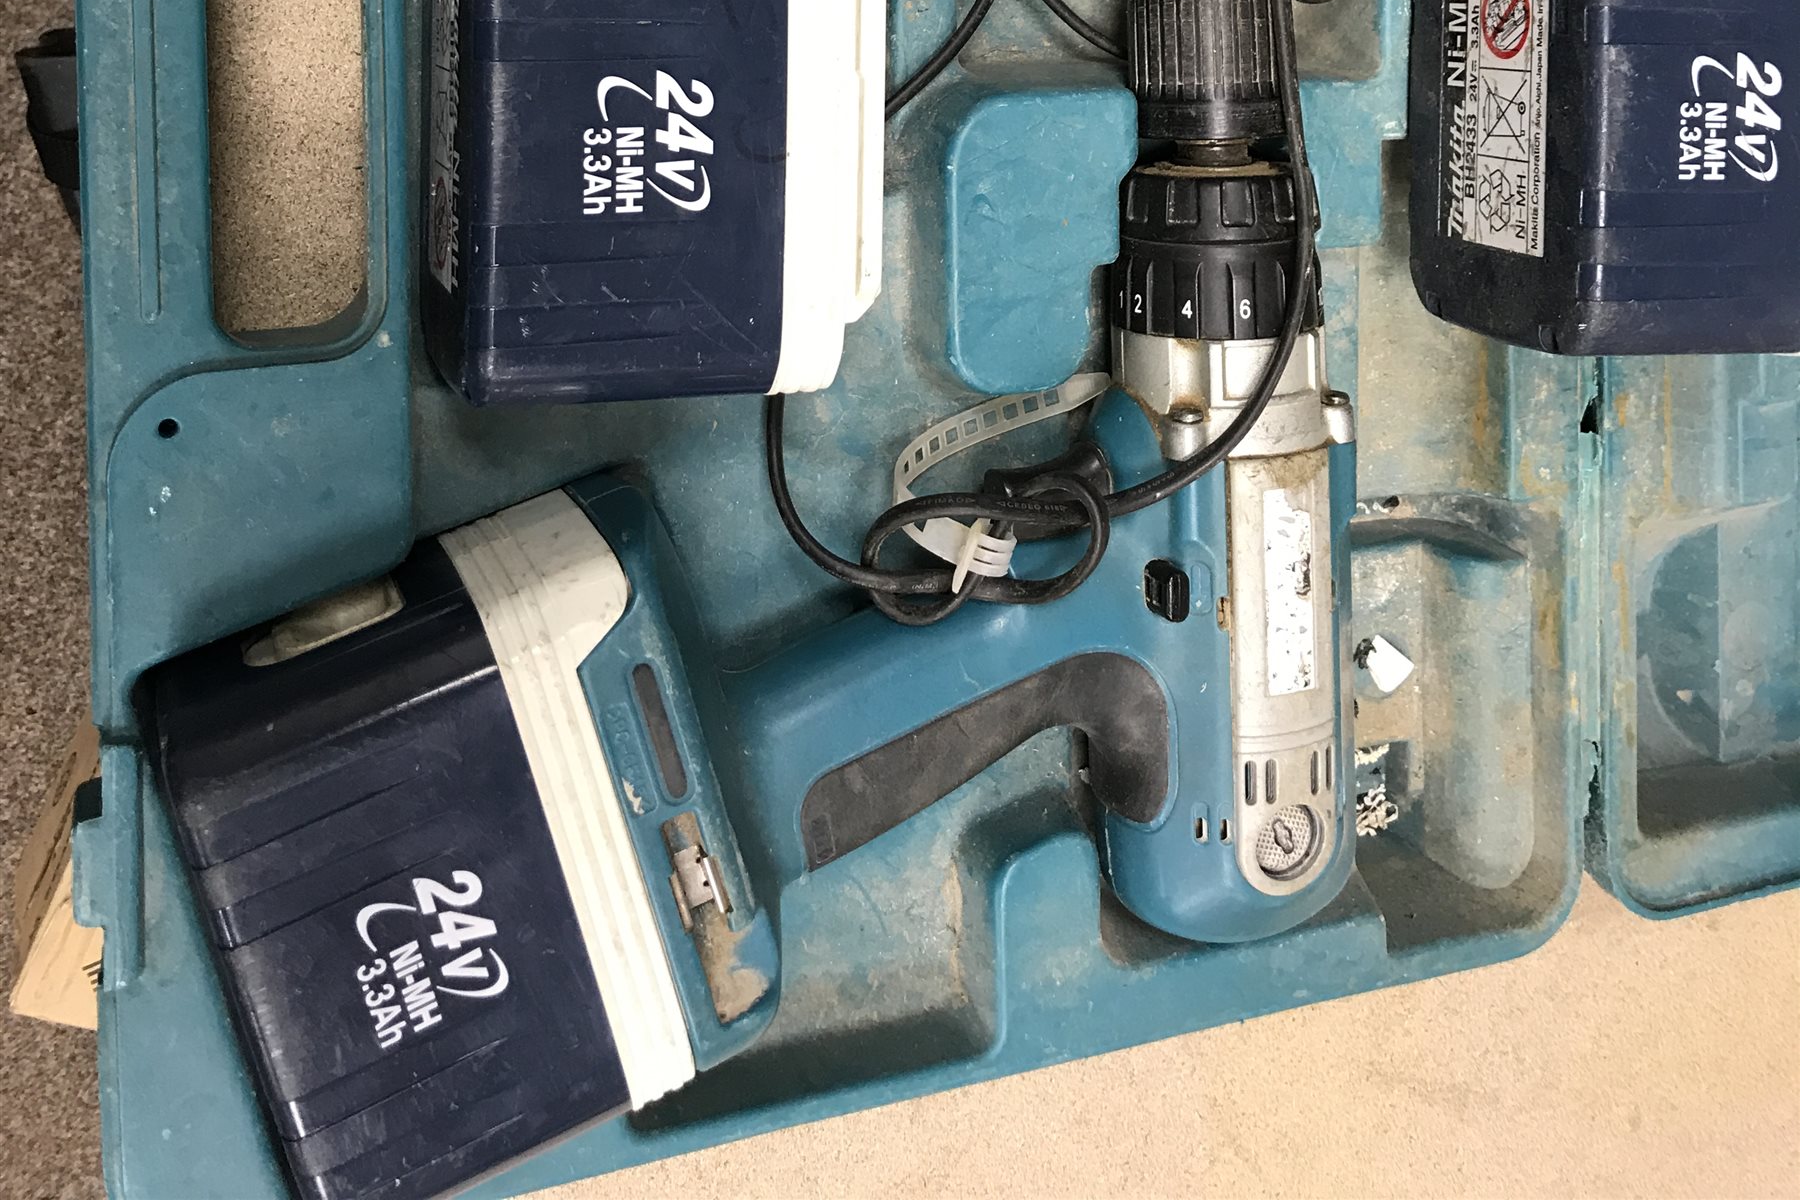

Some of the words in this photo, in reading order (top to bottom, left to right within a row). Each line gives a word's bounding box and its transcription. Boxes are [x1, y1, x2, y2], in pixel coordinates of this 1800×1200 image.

[1470, 5, 1480, 49] 3.3Ah
[582, 127, 613, 215] 3.3Ah
[615, 126, 645, 214] Ni-MH
[1464, 113, 1478, 199] BH2433
[1530, 131, 1542, 205] Corporation
[1679, 102, 1701, 180] 3.3Ah
[1703, 102, 1728, 181] Ni-MH
[1514, 173, 1527, 240] Ni-MH
[1134, 293, 1143, 314] 2
[1181, 299, 1193, 319] 4
[1239, 298, 1252, 320] 6
[356, 957, 407, 1049] 3.3Ah
[388, 939, 443, 1033] Ni-MH
